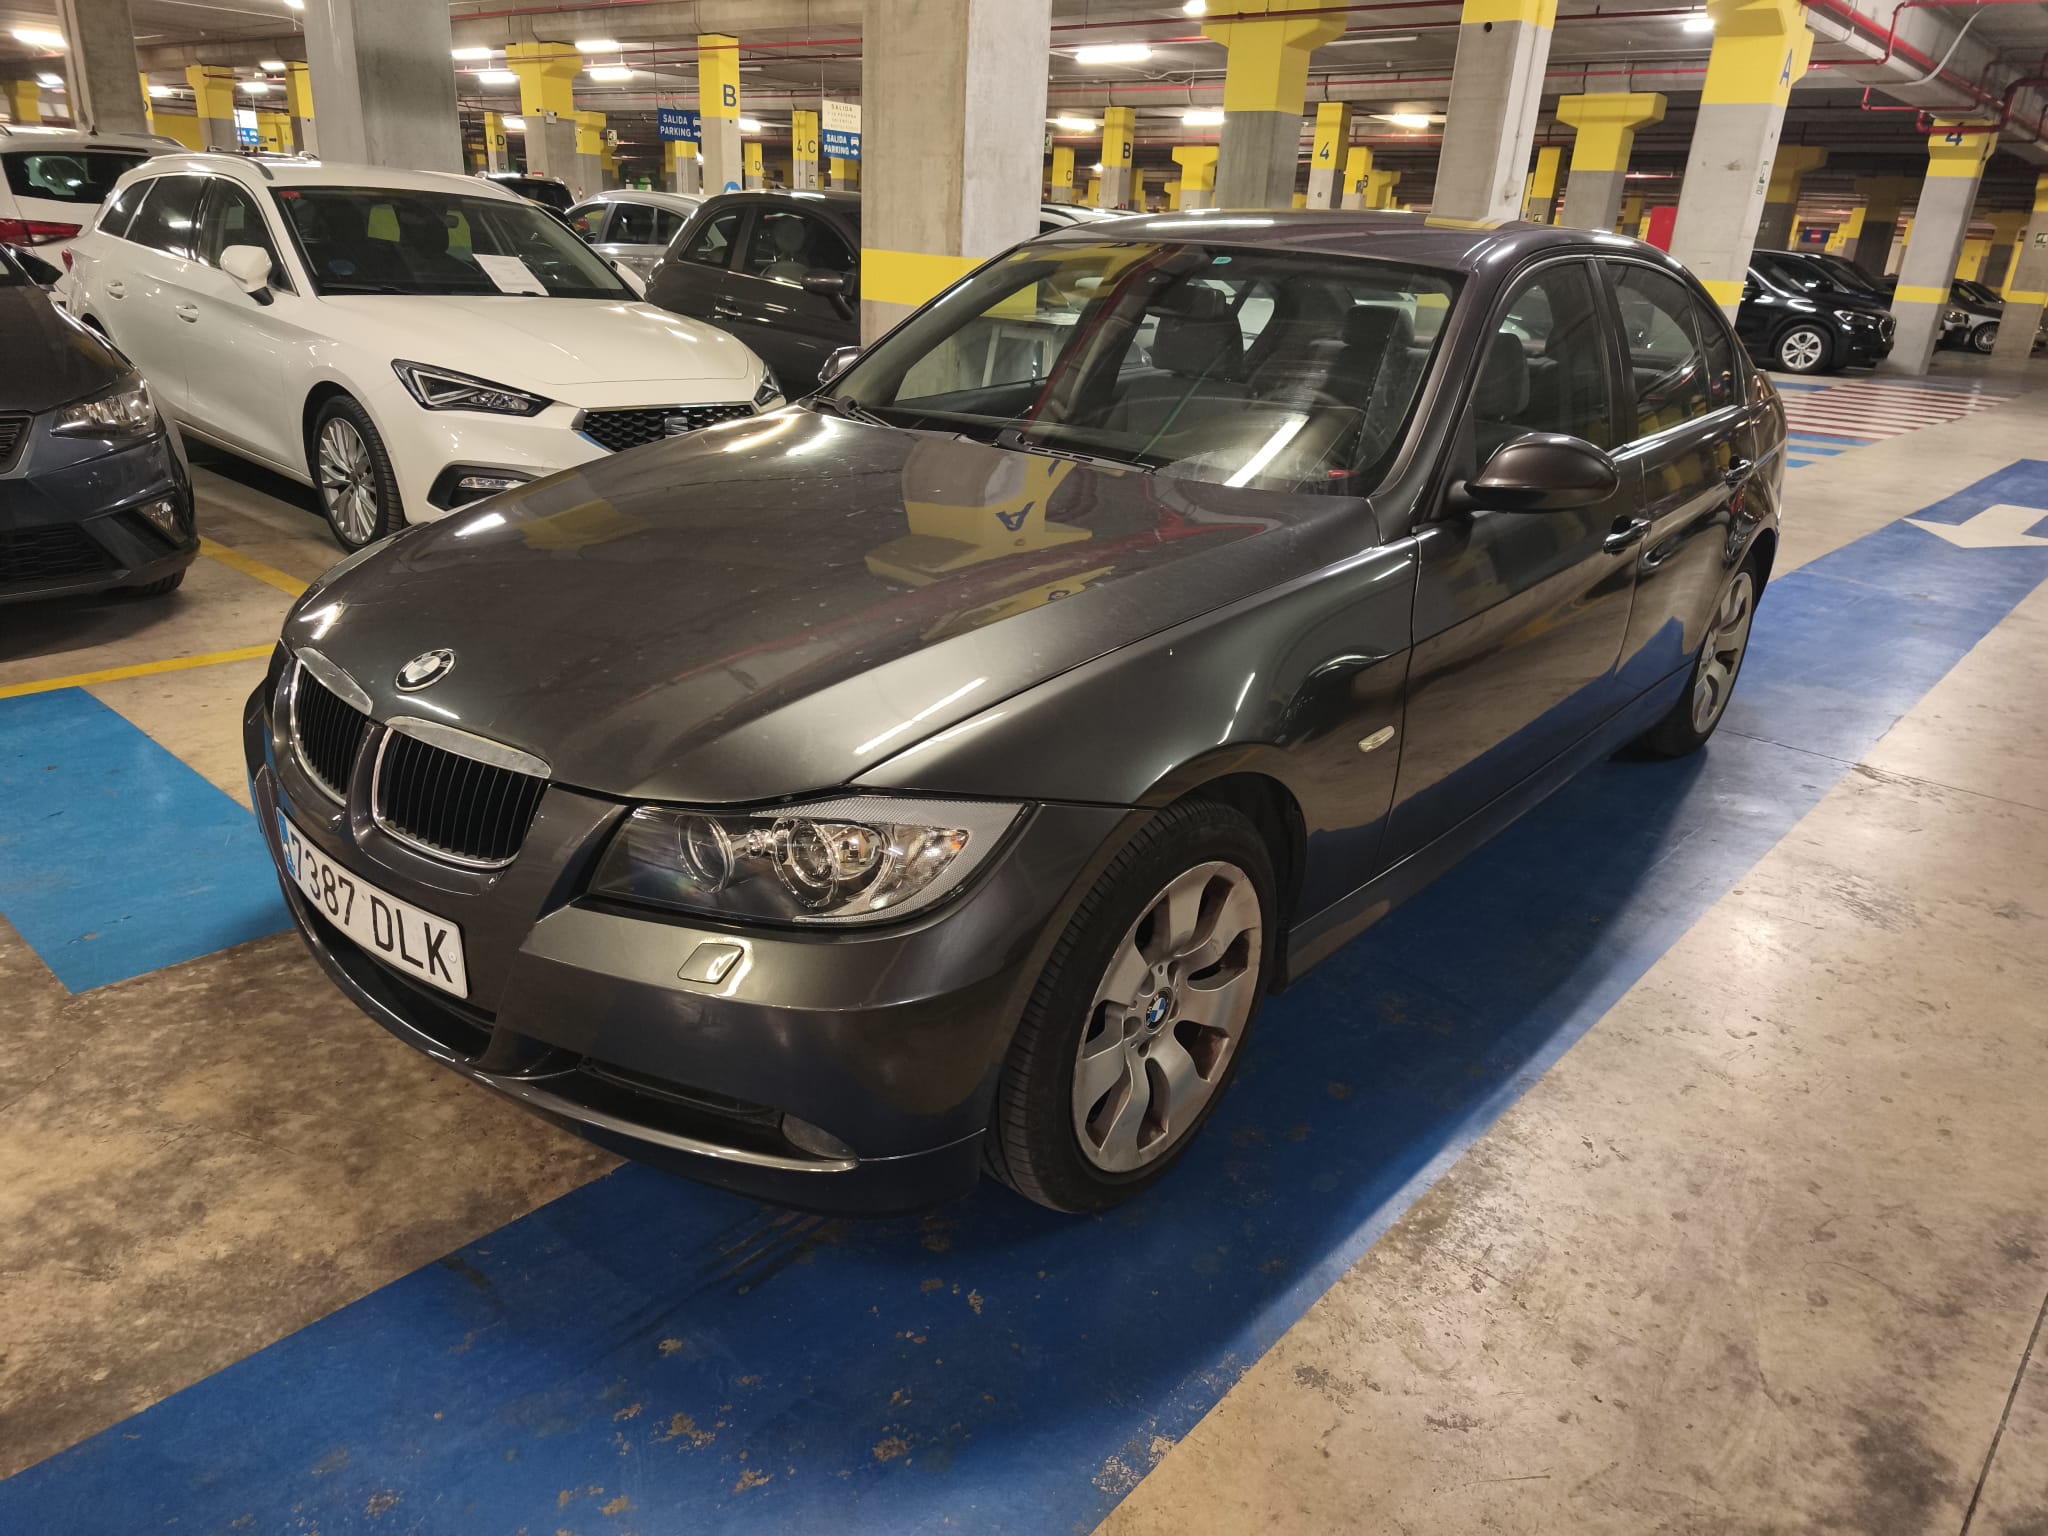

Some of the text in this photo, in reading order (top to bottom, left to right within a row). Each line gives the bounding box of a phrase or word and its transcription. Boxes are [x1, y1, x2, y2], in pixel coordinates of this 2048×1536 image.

[1779, 48, 1793, 88] A
[723, 84, 737, 107] B
[662, 114, 688, 125] SALIDA
[660, 126, 691, 138] PARKING
[496, 134, 505, 146] D
[826, 134, 847, 144] SALIDA
[807, 140, 816, 154] C
[824, 144, 849, 155] PARKING
[1123, 142, 1131, 159] B
[1319, 141, 1330, 160] 4
[754, 160, 761, 171] D
[1065, 169, 1073, 182] C
[290, 831, 453, 984] 7387 DLK
